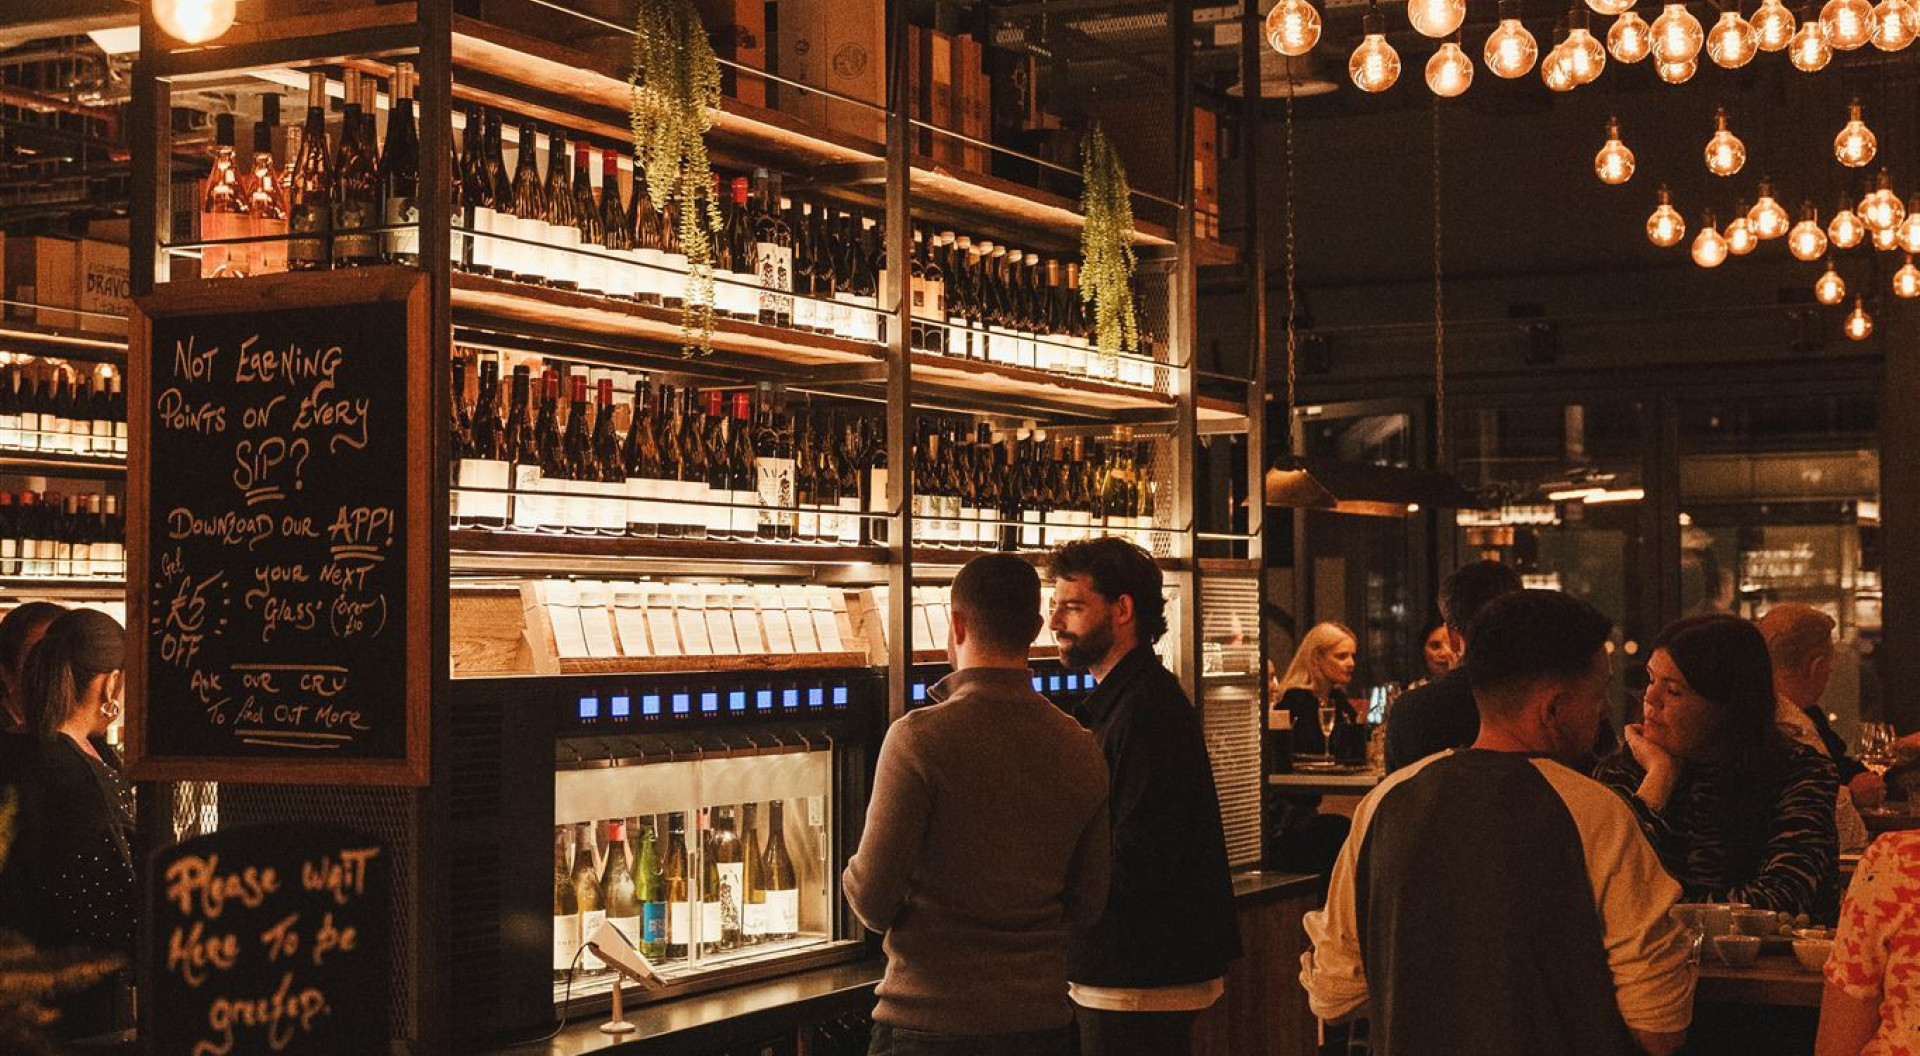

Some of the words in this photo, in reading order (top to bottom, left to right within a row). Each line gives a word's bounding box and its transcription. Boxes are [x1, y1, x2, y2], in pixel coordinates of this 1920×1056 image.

[87, 273, 130, 299] BRAVO
[327, 505, 395, 547] APP!
[161, 633, 204, 668] OFF
[300, 674, 347, 697] CRU
[165, 854, 280, 918] Please
[312, 912, 357, 965] be
